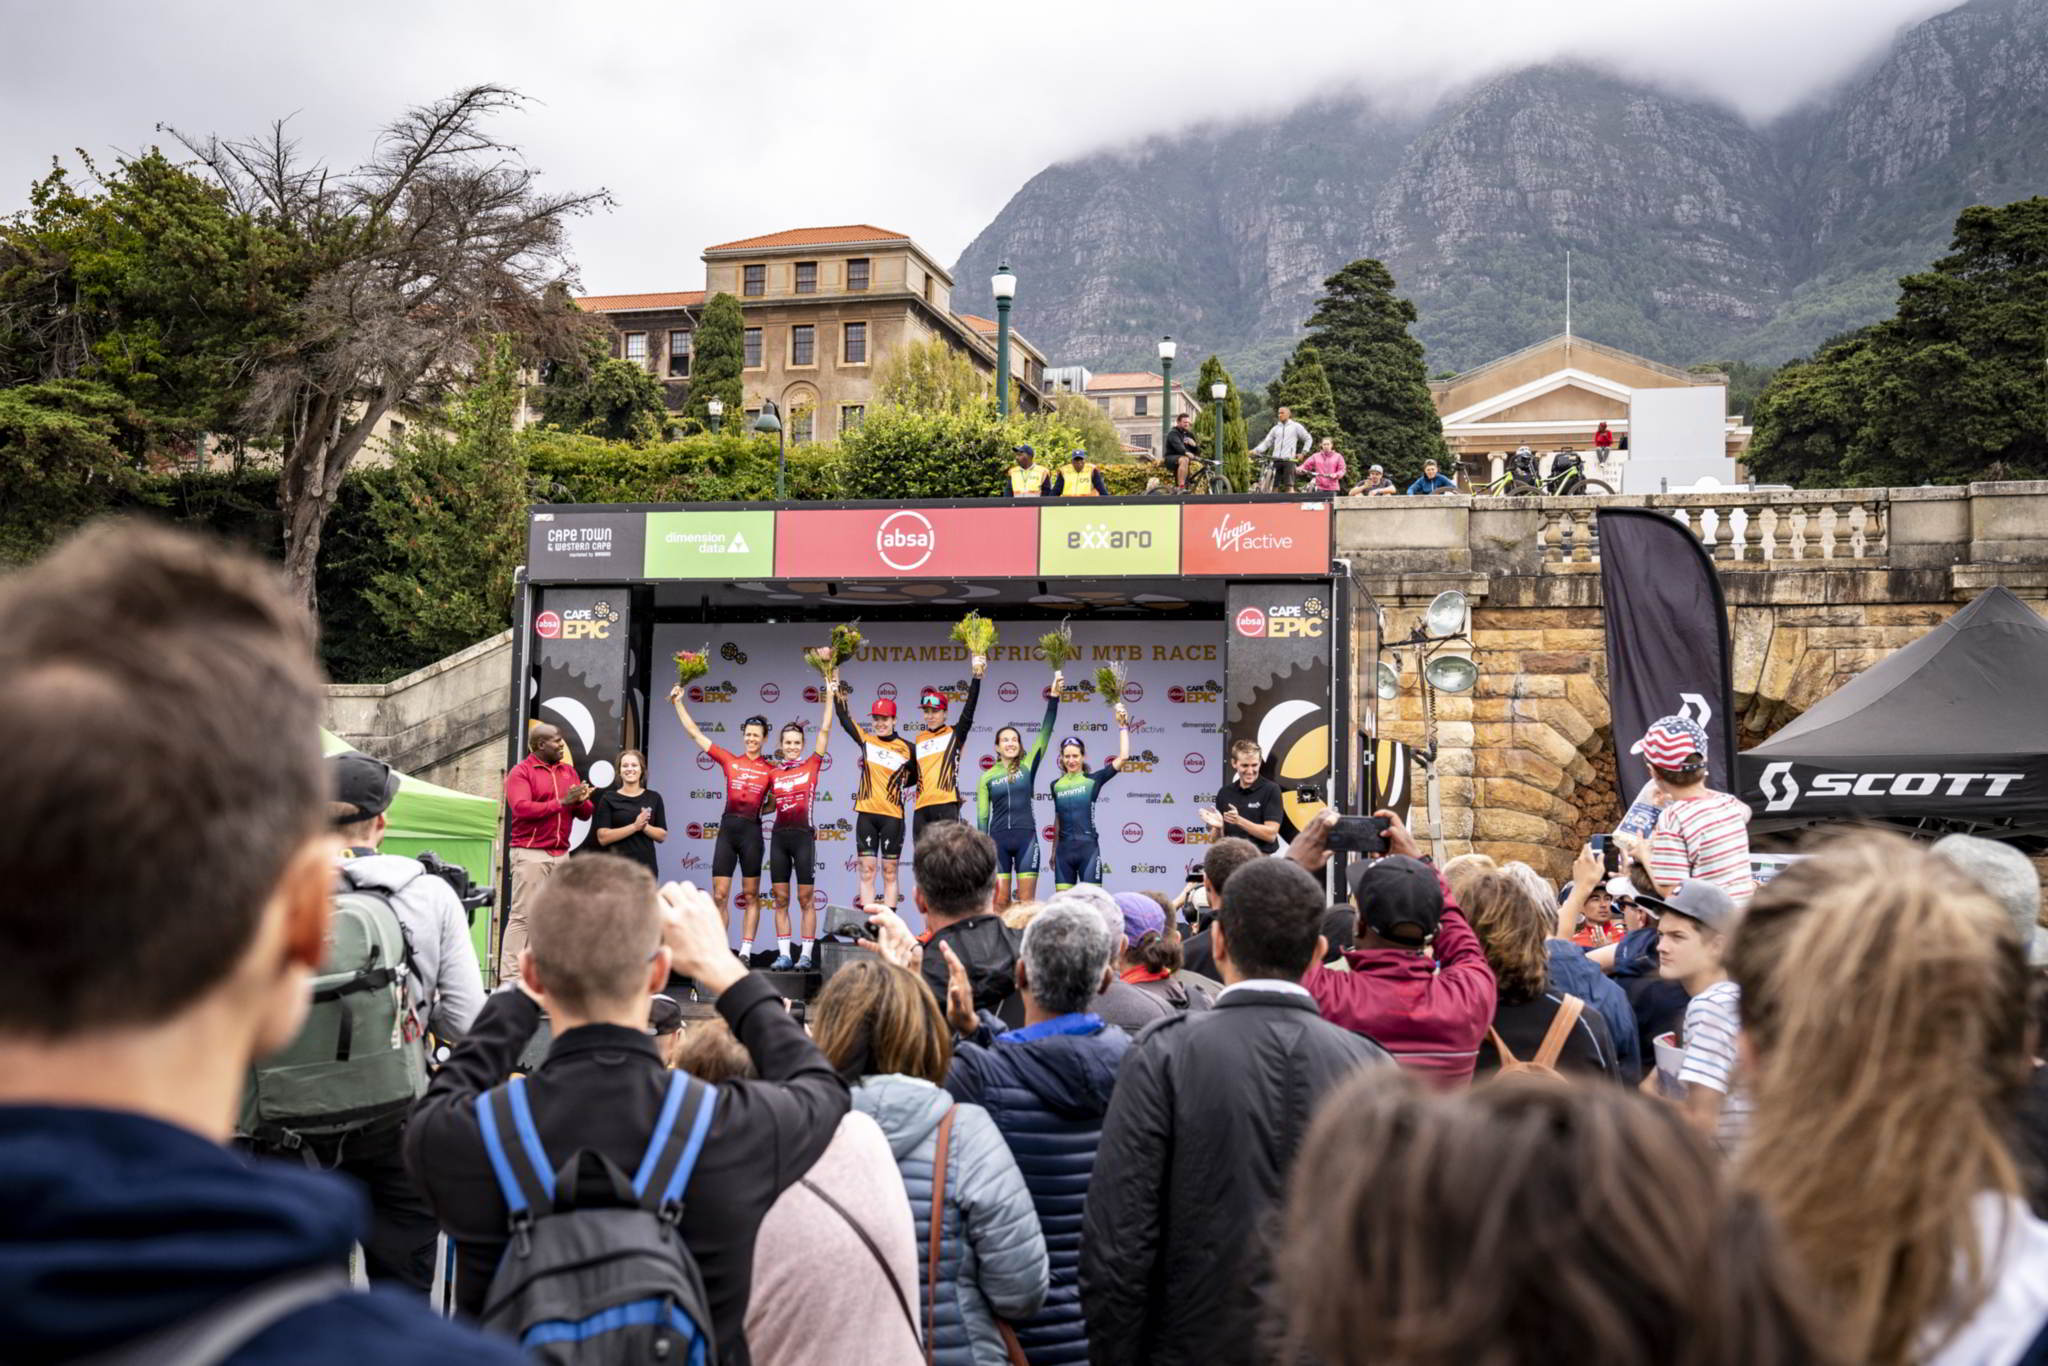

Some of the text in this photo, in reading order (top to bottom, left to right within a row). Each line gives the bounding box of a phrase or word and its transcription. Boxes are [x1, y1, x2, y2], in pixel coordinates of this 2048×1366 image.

[665, 531, 726, 543] dimension
[883, 528, 929, 547] absa
[1067, 523, 1152, 549] exxaro
[1211, 513, 1256, 552] Virgin
[1242, 533, 1293, 549] active
[699, 543, 726, 553] data
[563, 609, 592, 620] CAPE
[1268, 606, 1301, 617] CAPE
[1240, 616, 1262, 626] absa
[1268, 617, 1323, 638] EPIC
[562, 620, 610, 639] EPIC
[855, 645, 969, 662] UNTAMED
[1091, 645, 1143, 661] MTB
[1152, 645, 1217, 661] RACE
[1185, 692, 1217, 703] EPIC
[1073, 721, 1108, 732] exxaro
[1186, 758, 1203, 766] absa
[1804, 772, 2026, 797] SCOTT
[1057, 785, 1086, 799] summit
[1130, 862, 1167, 873] exxaro
